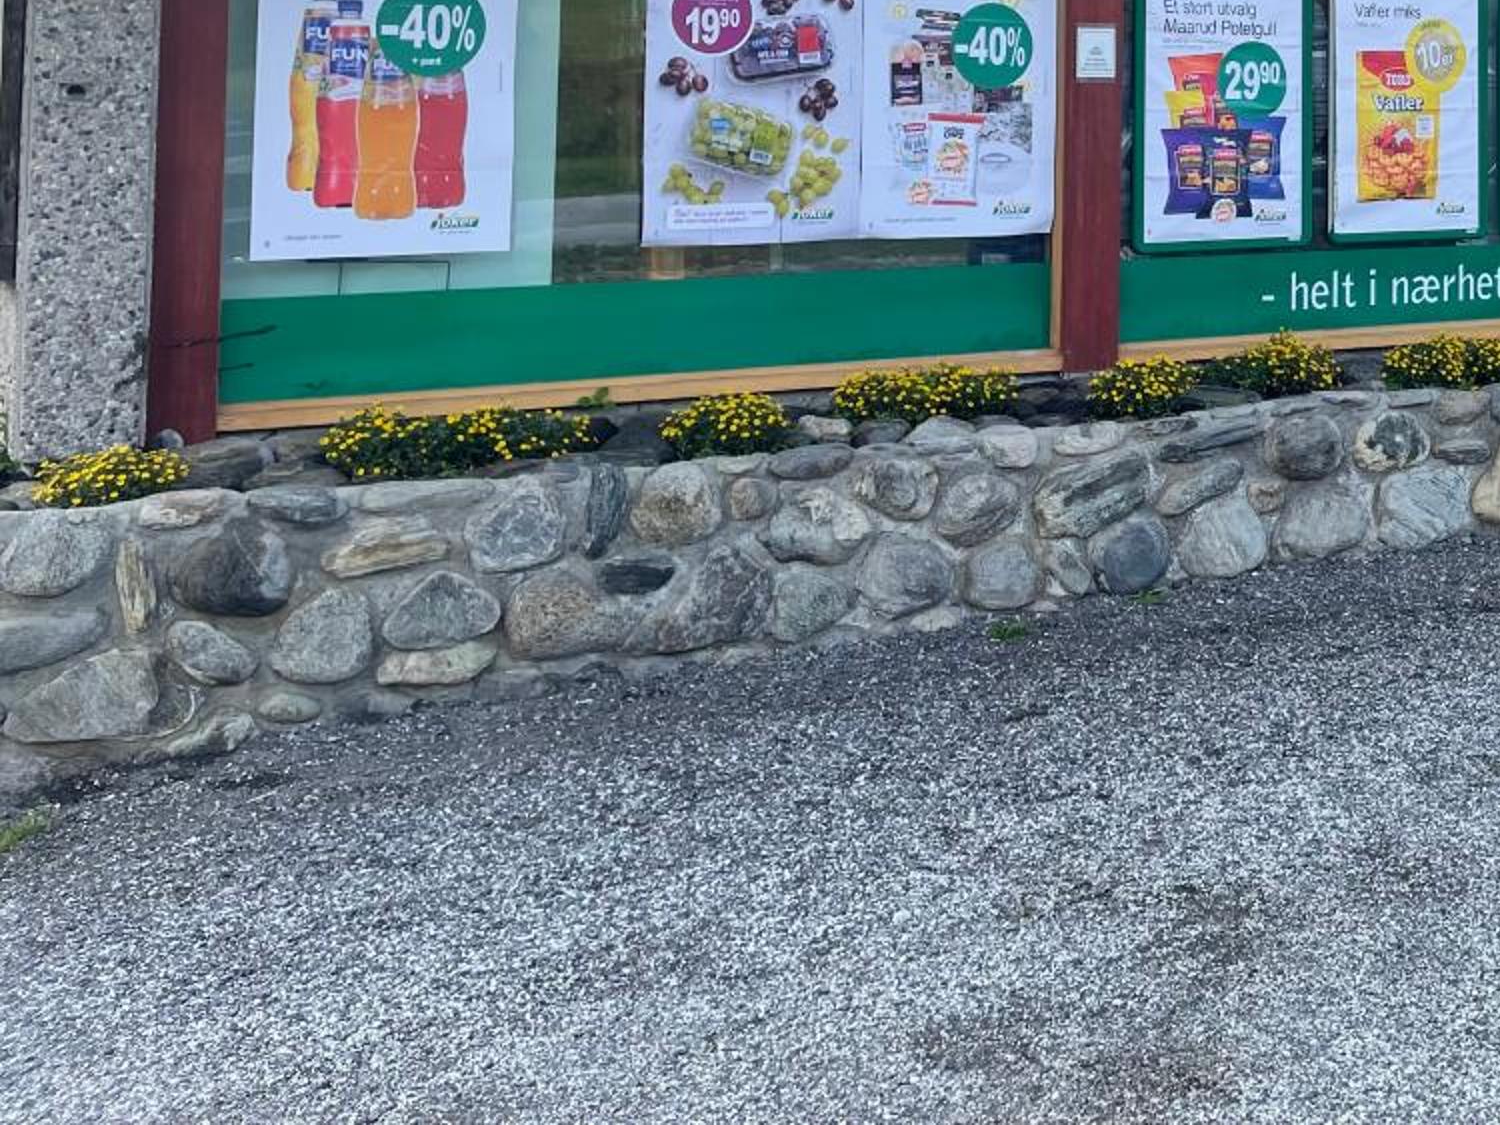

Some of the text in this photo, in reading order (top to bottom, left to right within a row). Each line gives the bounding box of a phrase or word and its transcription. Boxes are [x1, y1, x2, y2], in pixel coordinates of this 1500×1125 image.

[381, 4, 475, 52] -40%
[1163, 17, 1217, 35] Maarud
[1183, 0, 1213, 16] stort
[1217, 1, 1257, 20] utvalg
[954, 26, 1026, 68] -40%
[1290, 269, 1357, 311] helt
[1369, 268, 1377, 306] i
